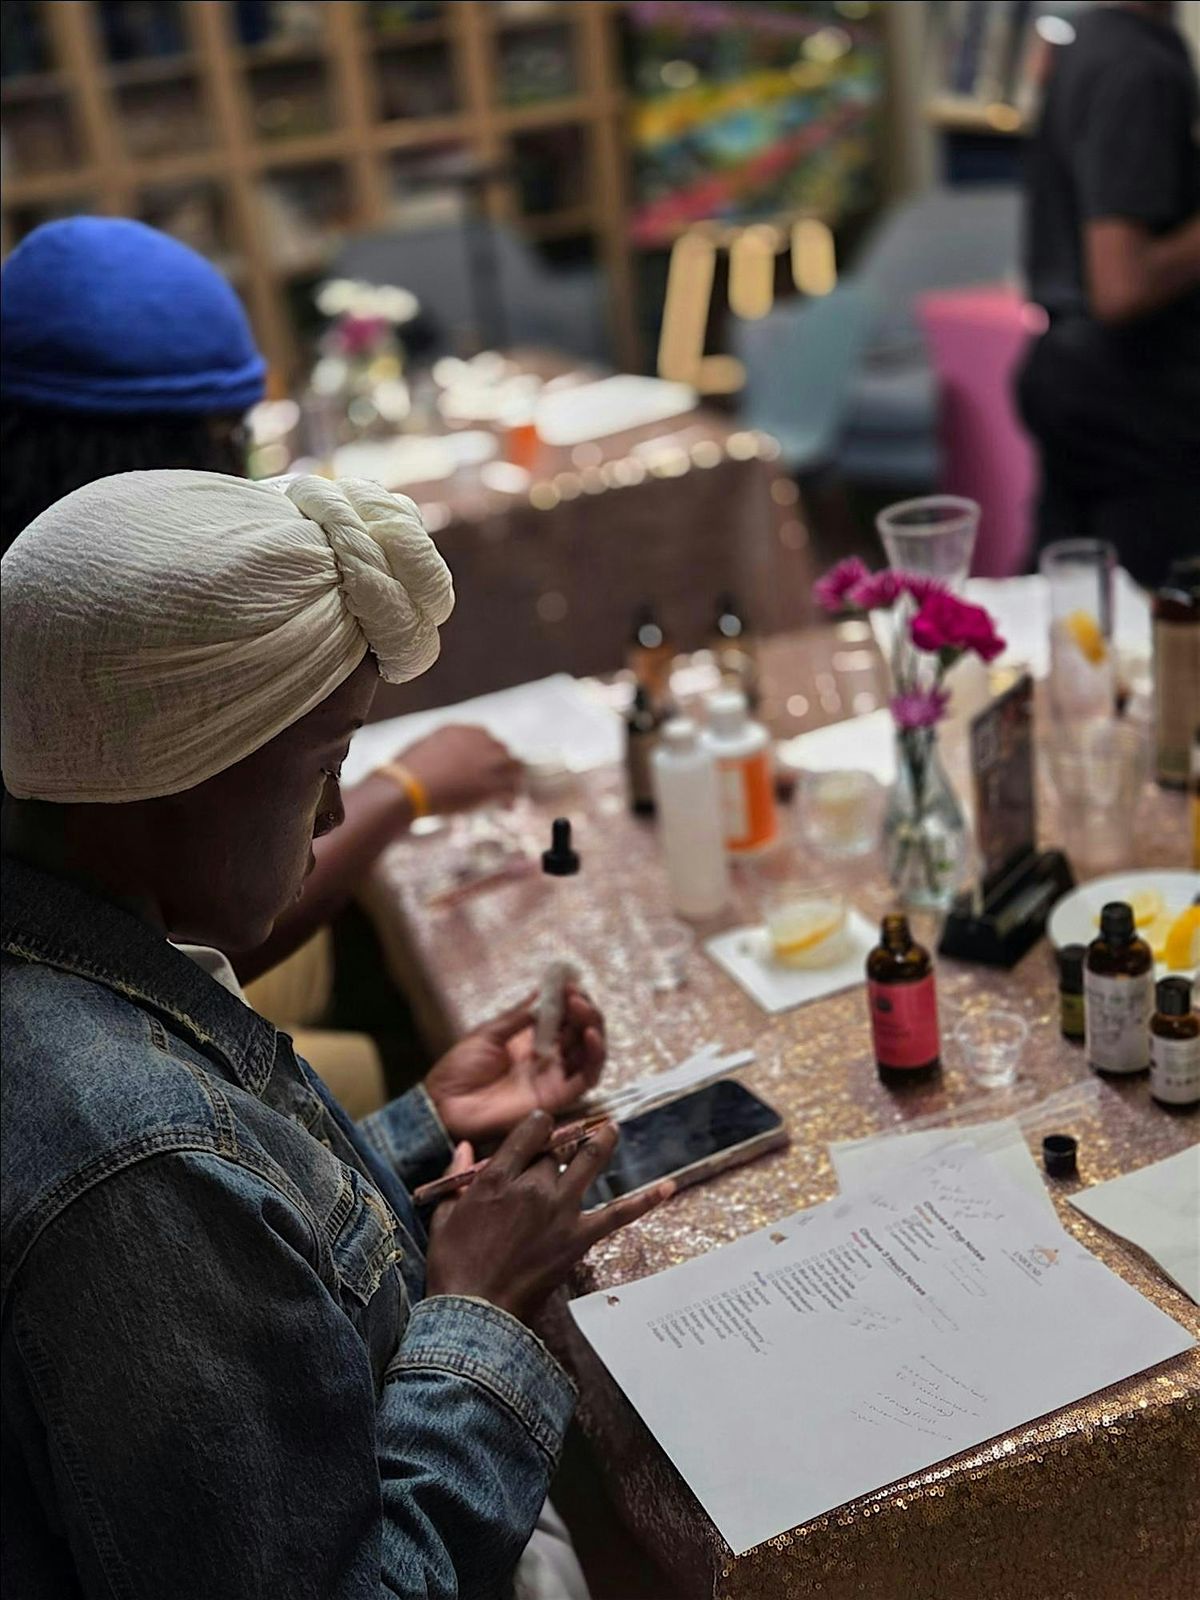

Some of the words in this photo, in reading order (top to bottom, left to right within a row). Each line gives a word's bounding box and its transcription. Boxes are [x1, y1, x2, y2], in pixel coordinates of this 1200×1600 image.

[860, 1228, 883, 1252] Choose
[888, 1257, 907, 1276] Heart
[906, 1275, 926, 1296] Notes
[924, 1201, 948, 1226] Choose
[954, 1230, 966, 1242] Top
[966, 1241, 986, 1261] Notes
